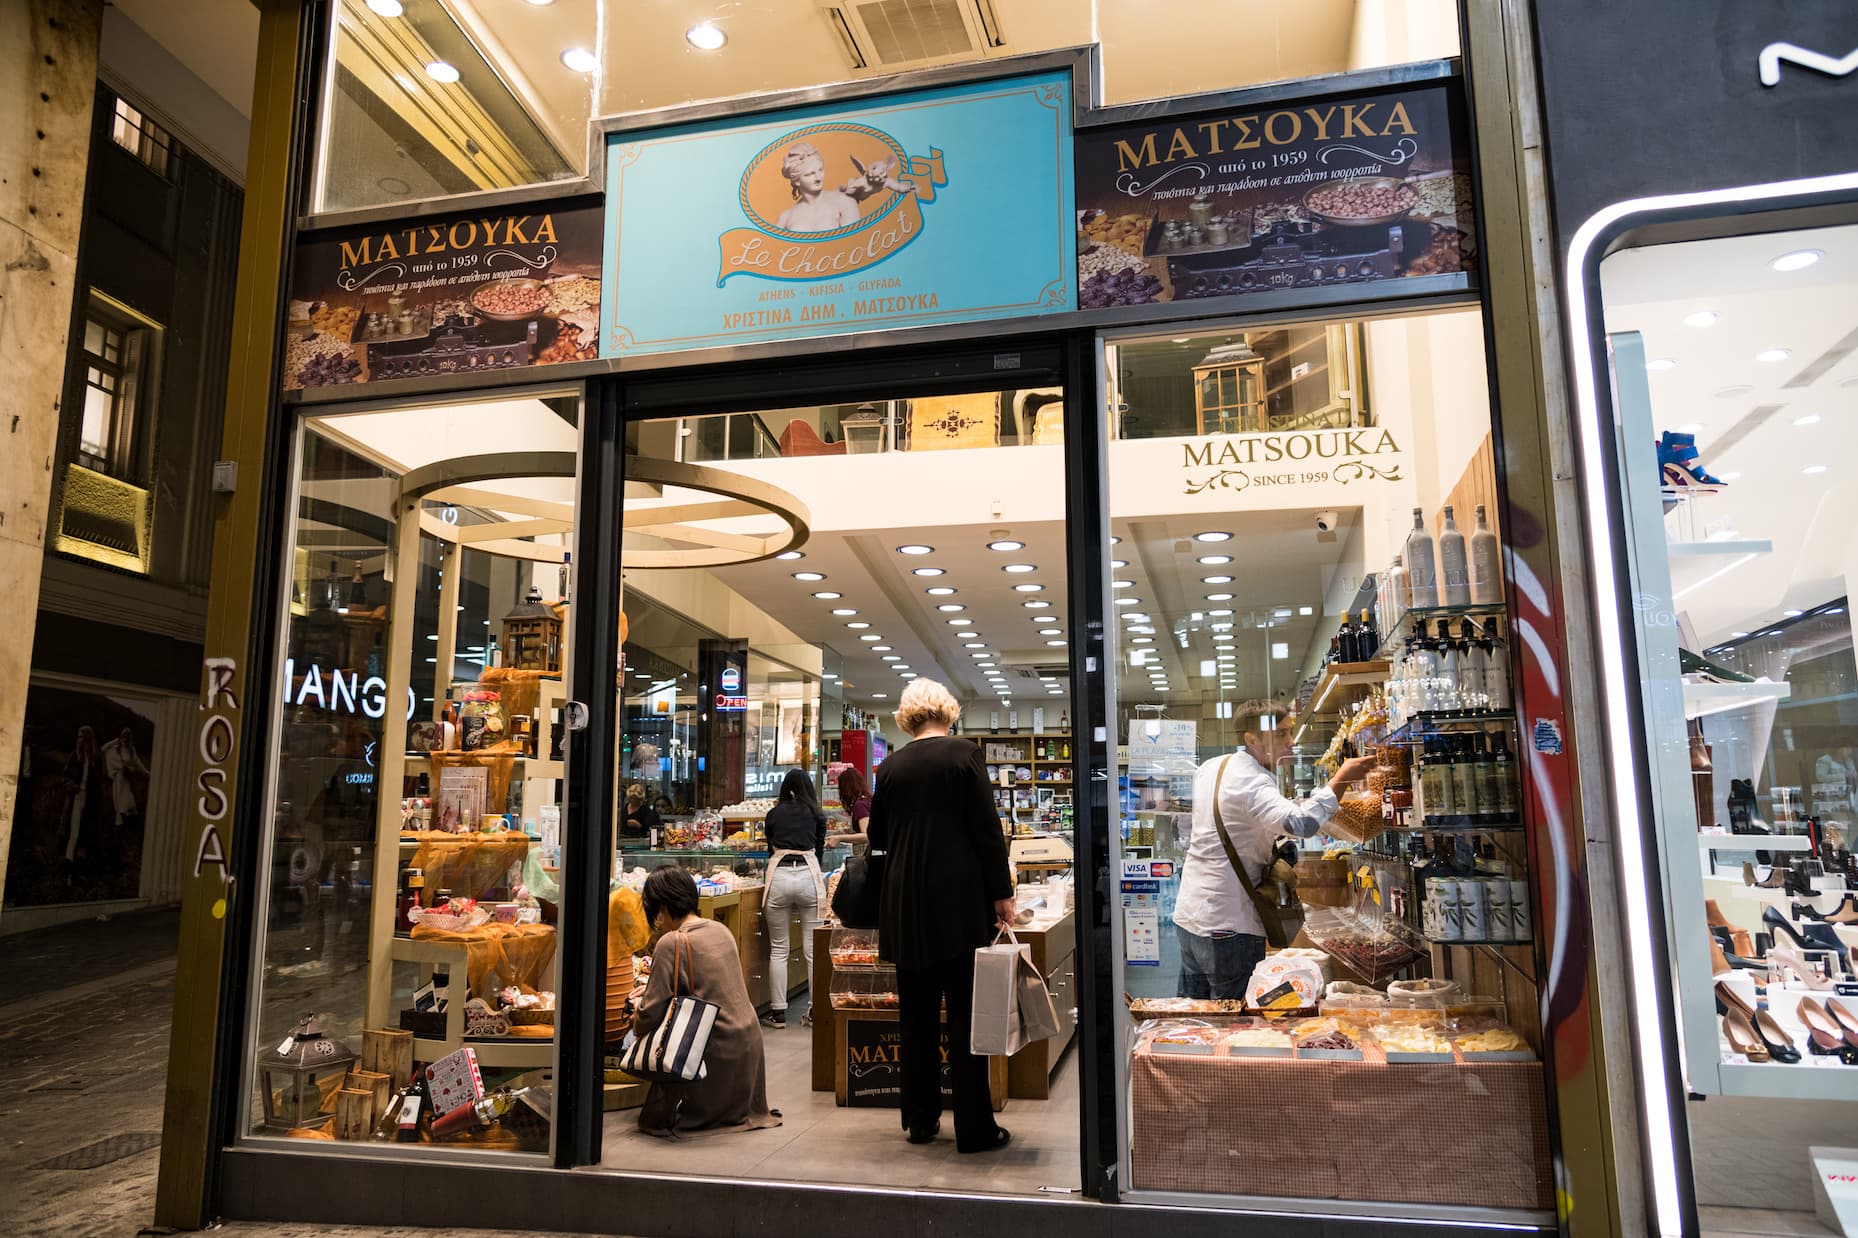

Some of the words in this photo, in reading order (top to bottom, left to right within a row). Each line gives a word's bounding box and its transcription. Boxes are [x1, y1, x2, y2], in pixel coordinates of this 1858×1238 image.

[1113, 101, 1418, 173] ΜΑΤΣΟΥΚΑ
[1218, 159, 1247, 175] από
[1251, 161, 1266, 171] το
[1272, 150, 1308, 168] 1959
[1198, 182, 1215, 196] και
[1270, 176, 1282, 187] σε
[339, 214, 559, 270] ΜΑΤΣΟΥΚΑ
[730, 238, 770, 267] Le
[779, 210, 913, 273] Chocolat
[436, 263, 448, 271] το
[452, 254, 478, 269] 1959
[759, 287, 796, 302] ATHENS
[808, 282, 845, 298] KIFISIA
[857, 276, 902, 293] GLYFADA
[722, 307, 793, 330] ΧΡΙΣΤΙΝΑ
[853, 292, 940, 317] ΜΑΤΣΟΥΚΑ
[1181, 428, 1403, 468] MATSOUKA
[1253, 473, 1296, 487] SINCE
[1300, 471, 1329, 484] 1959
[1127, 864, 1147, 872] VISA
[1132, 881, 1157, 890] cardlink
